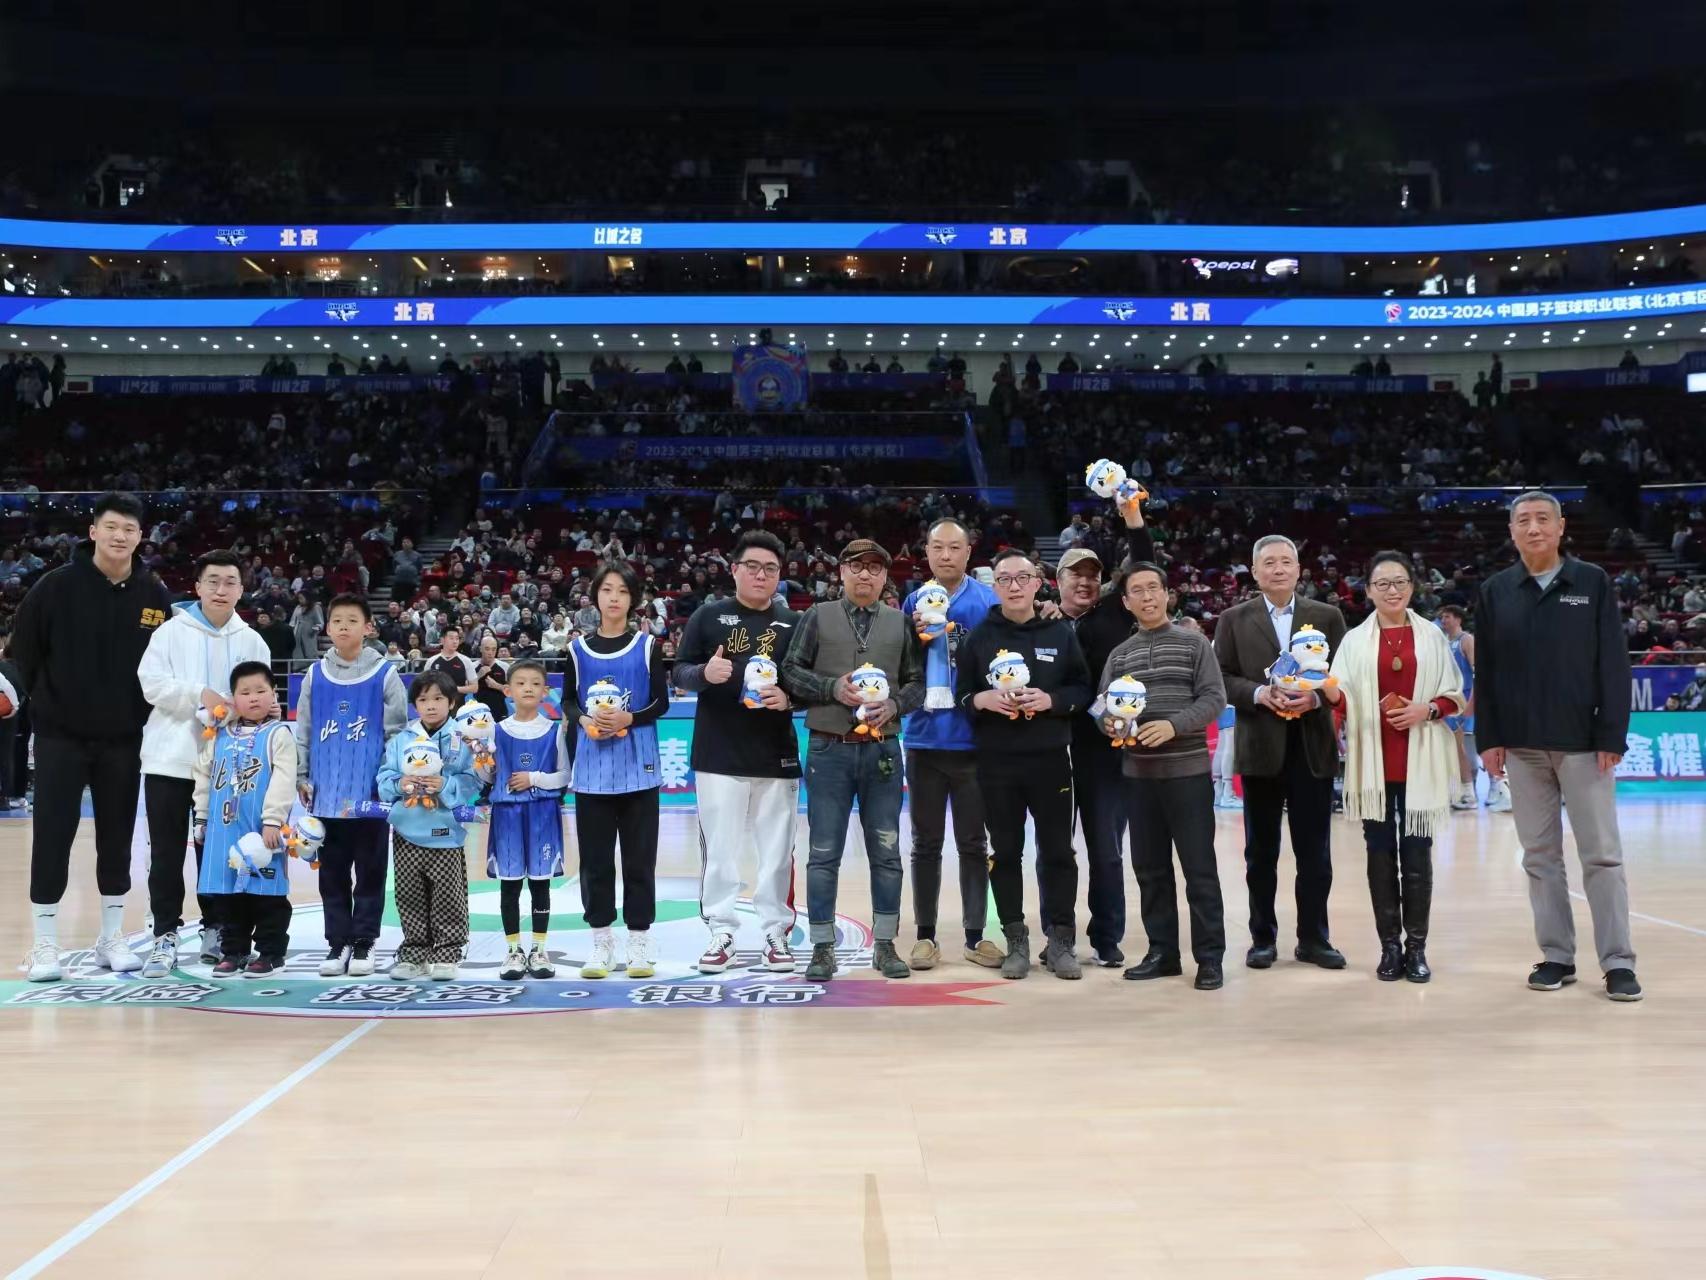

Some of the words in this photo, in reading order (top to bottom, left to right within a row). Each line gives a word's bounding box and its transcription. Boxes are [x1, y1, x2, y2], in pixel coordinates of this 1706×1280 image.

[280, 228, 318, 247] 北京
[989, 227, 1027, 245] 北京
[1203, 259, 1257, 271] pepsi
[393, 302, 435, 321] 北京
[1170, 302, 1211, 321] 北京
[1408, 304, 1494, 320] 2023-2024
[727, 627, 777, 656] 北京
[320, 715, 367, 742] 北京
[8, 983, 223, 1004] 保险
[311, 984, 526, 1004] 投资
[628, 984, 826, 1005] 银行
